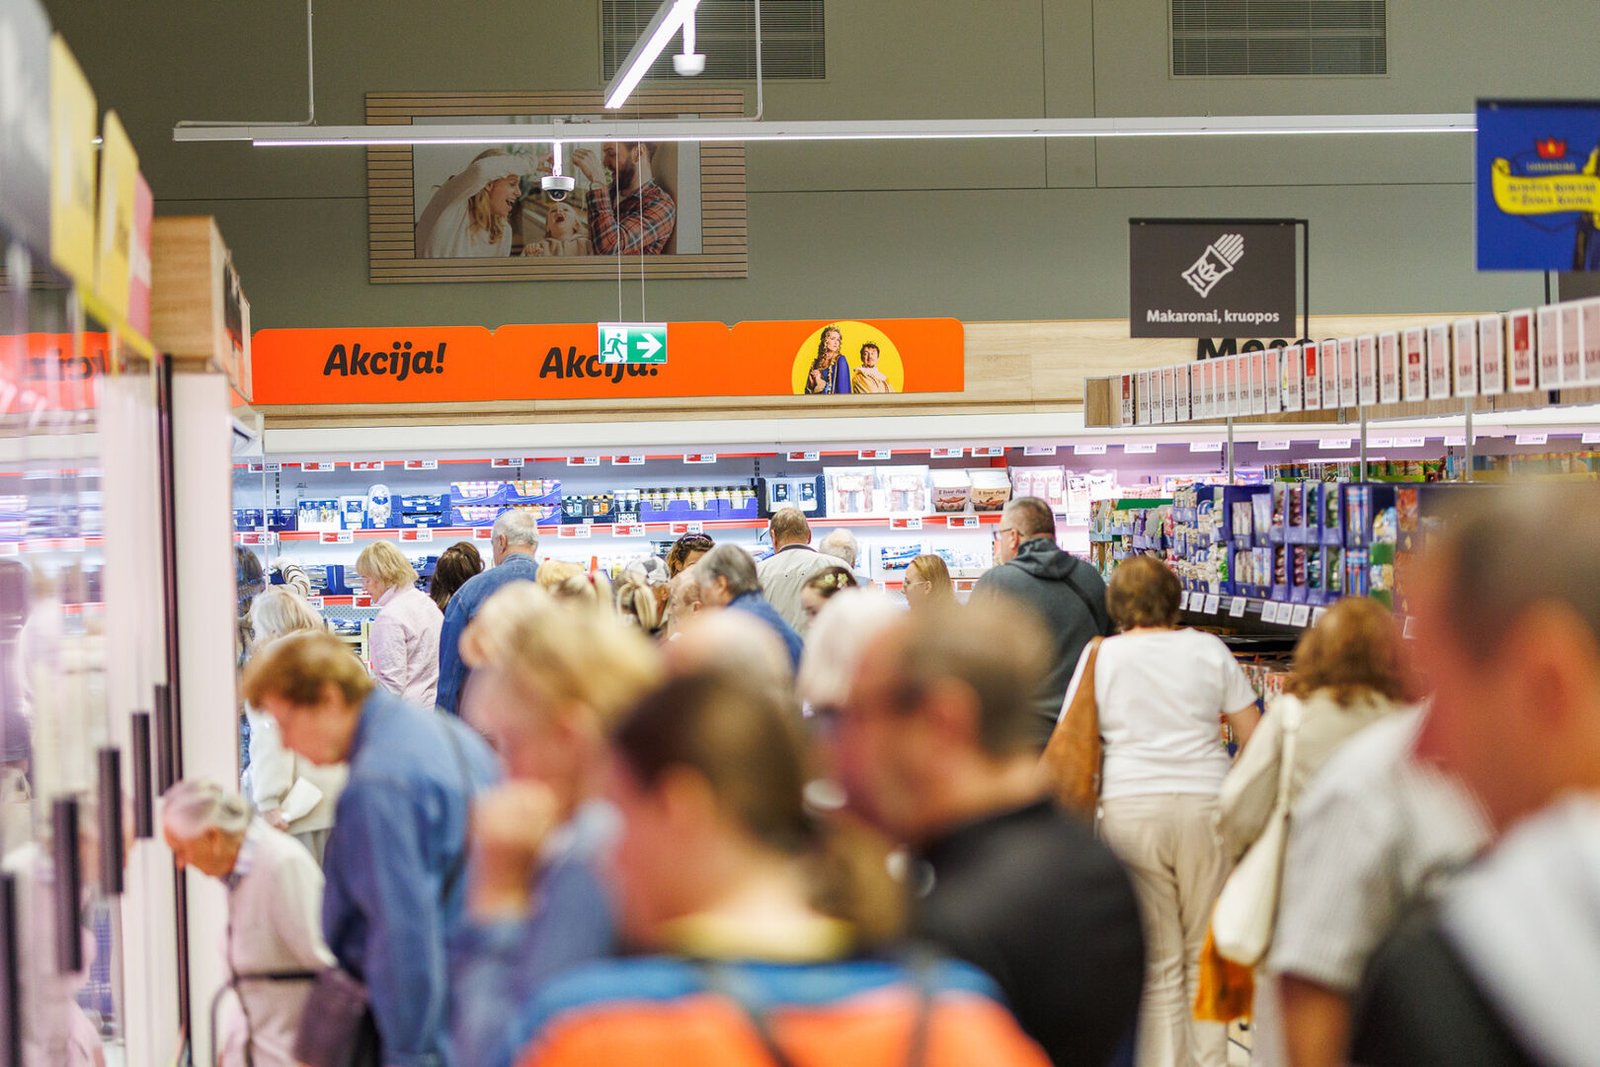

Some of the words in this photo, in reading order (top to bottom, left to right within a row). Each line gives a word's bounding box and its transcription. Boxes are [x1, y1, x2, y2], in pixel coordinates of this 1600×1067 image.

[1146, 309, 1222, 324] Makaronai,
[1224, 310, 1280, 325] kruopos
[323, 341, 447, 382] Akcija!
